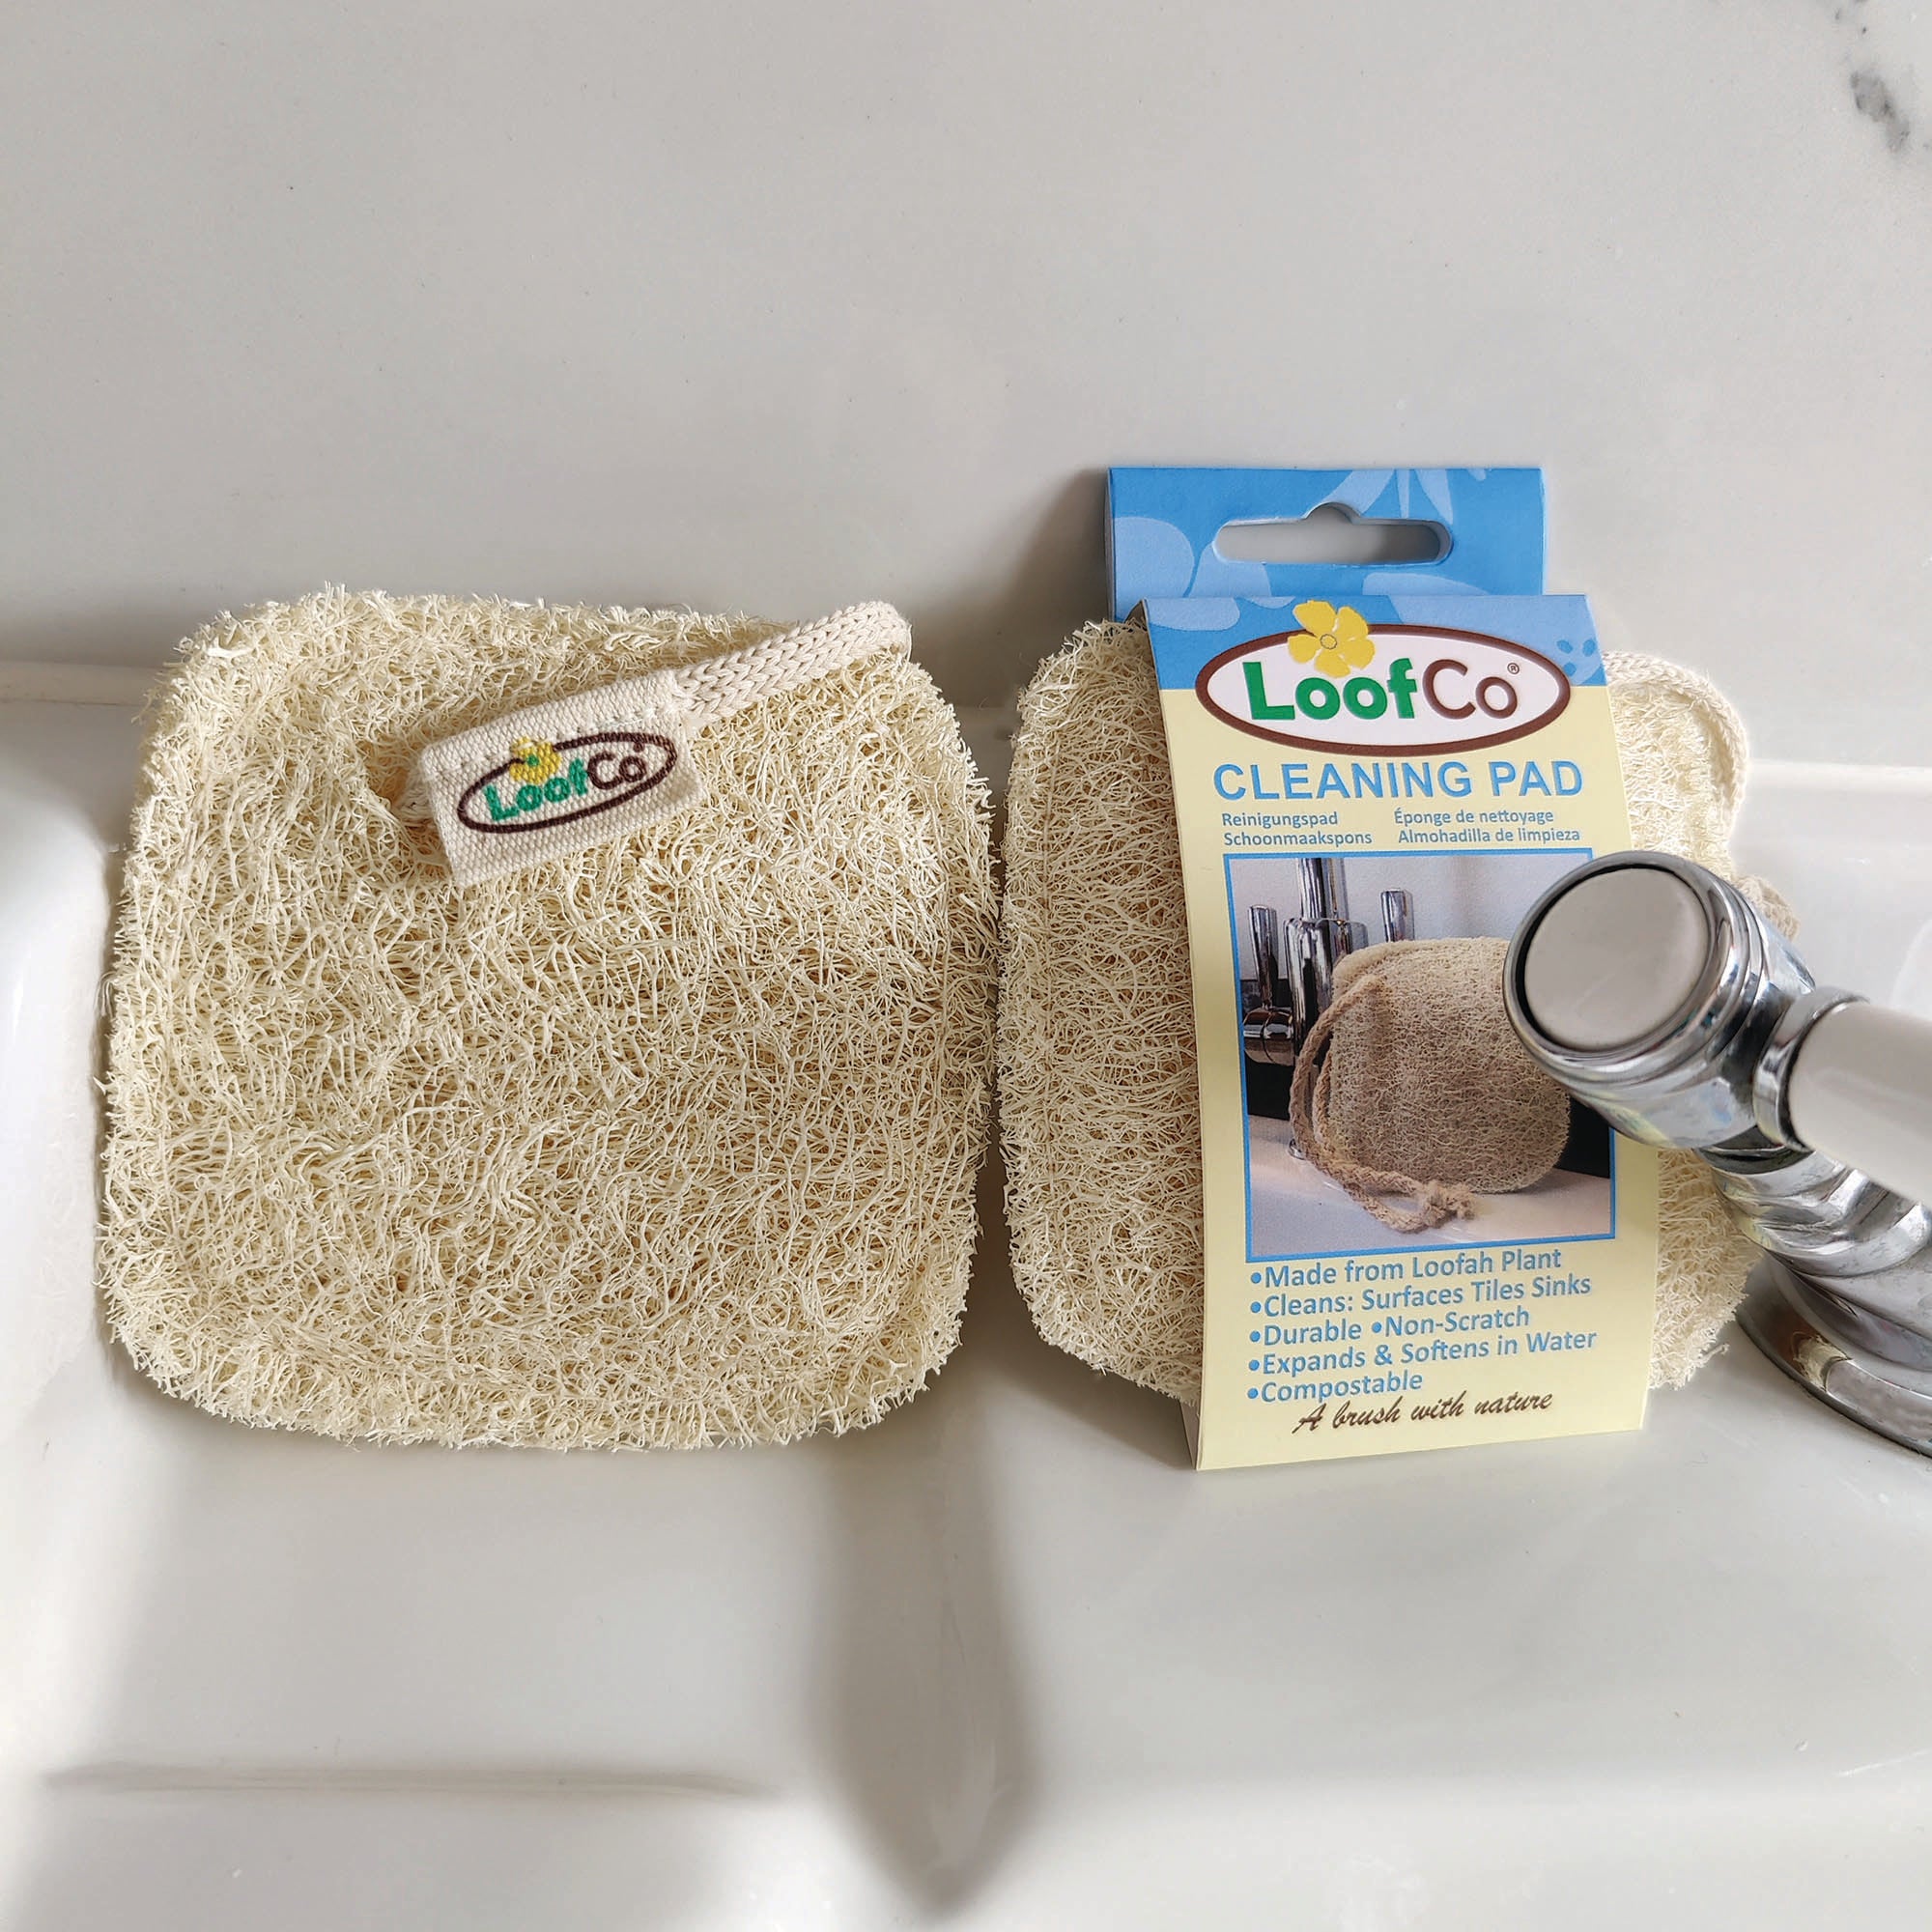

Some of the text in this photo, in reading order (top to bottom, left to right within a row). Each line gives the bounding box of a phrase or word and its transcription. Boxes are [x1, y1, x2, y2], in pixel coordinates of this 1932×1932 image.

[485, 750, 647, 821] LoofCo
[1213, 760, 1582, 800] CLEANING PAD
[1222, 811, 1338, 828] Reinigungspad
[1394, 807, 1553, 827] Éponge de nettoyage
[1224, 831, 1372, 847] Schoonmaakspons
[1399, 827, 1579, 845] Almohadilla de limpieza
[1265, 1248, 1561, 1289] Made from Loofah Plant
[1361, 1285, 1463, 1311] Surfaces
[1470, 1279, 1524, 1302] Tiles
[1532, 1274, 1590, 1297] Sinks
[1264, 1321, 1361, 1346] Durable
[1263, 1329, 1596, 1377] Expands & Softens in Water
[1262, 1371, 1423, 1404] Compostable
[1293, 1391, 1552, 1434] A brush with nature
